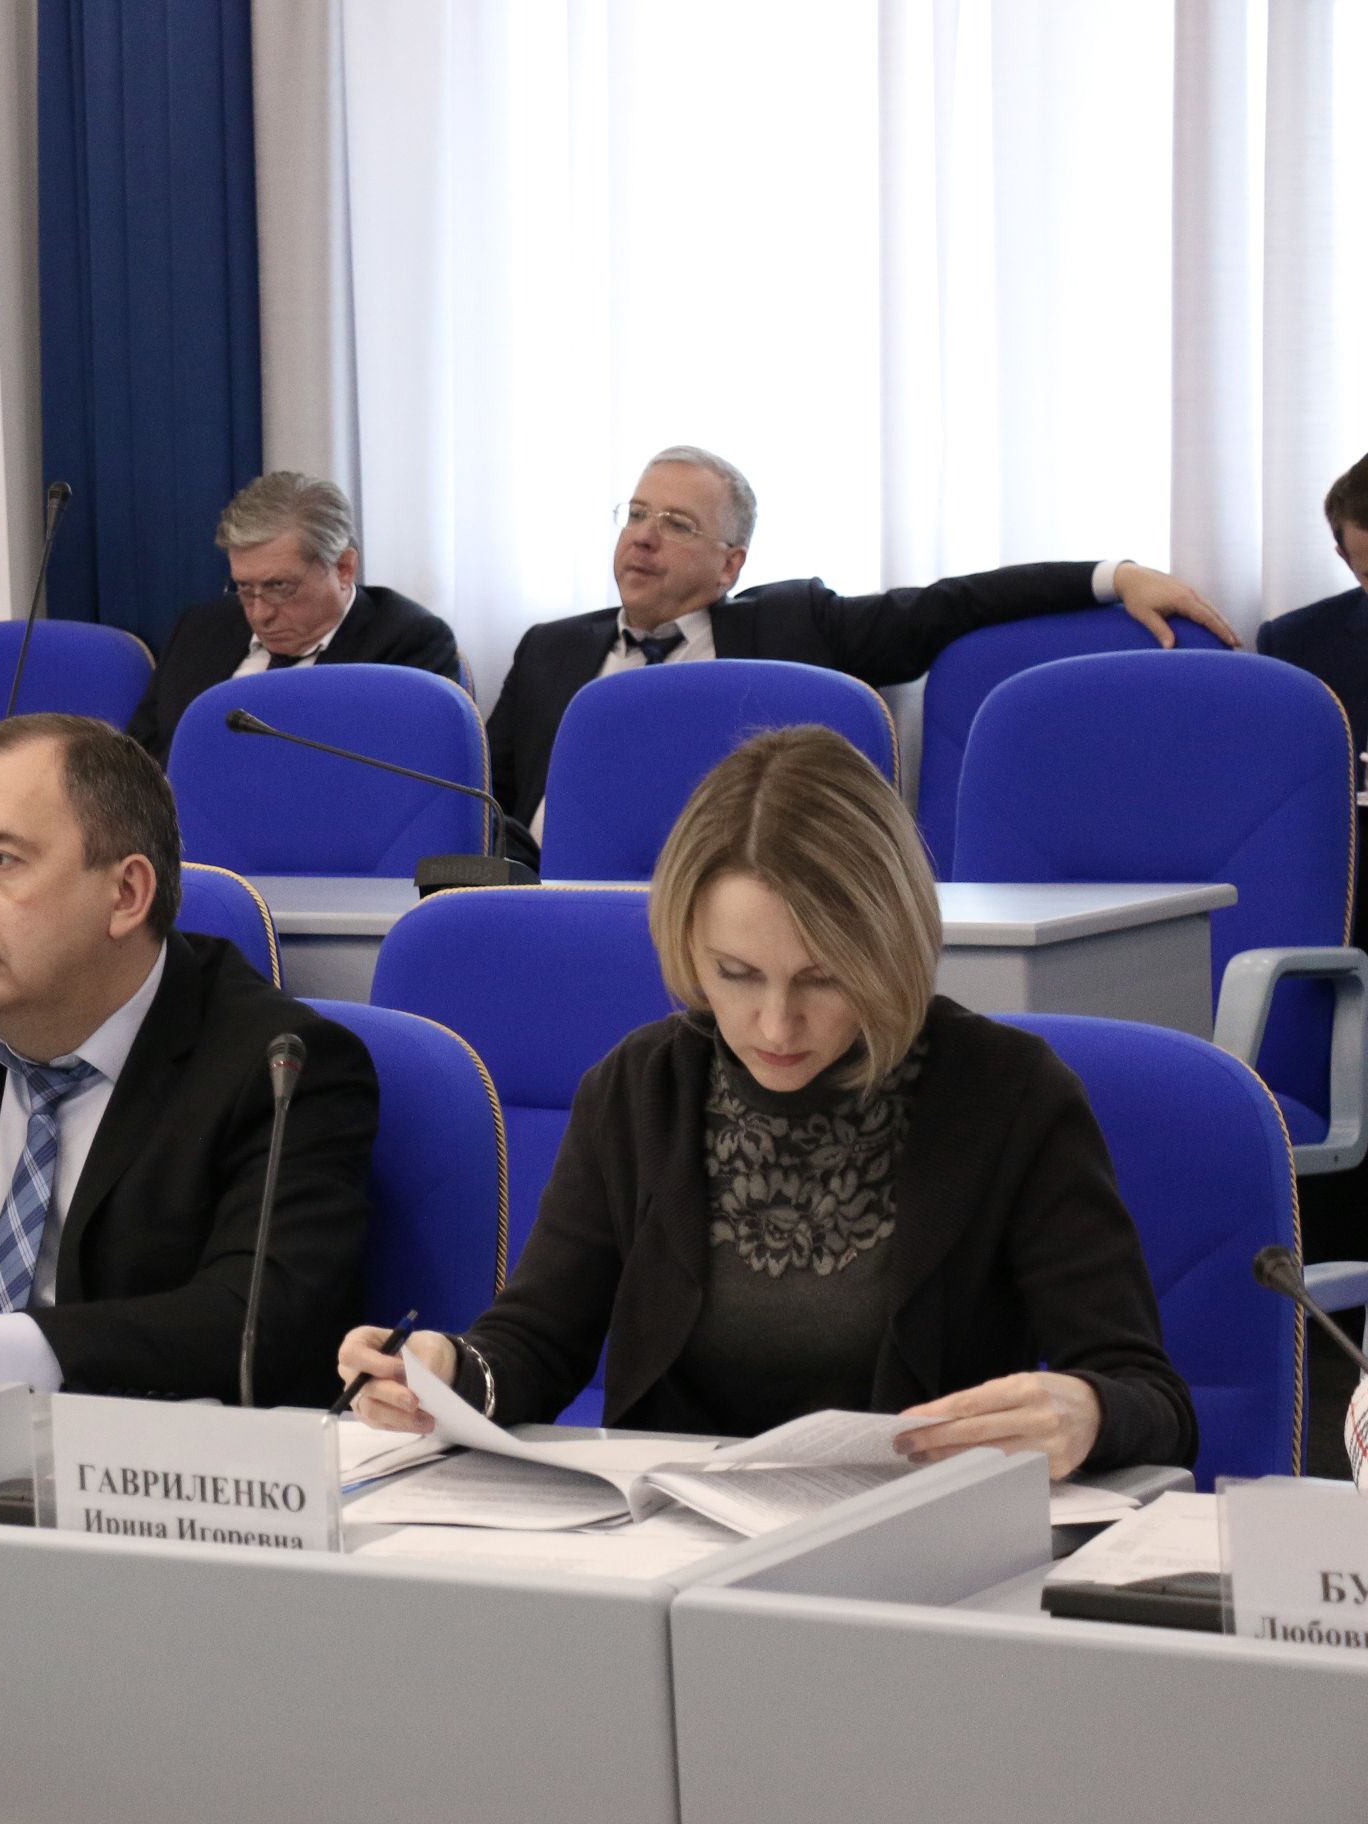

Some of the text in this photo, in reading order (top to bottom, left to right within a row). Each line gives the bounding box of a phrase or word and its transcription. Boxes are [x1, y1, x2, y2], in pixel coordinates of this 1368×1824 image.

[77, 1464, 306, 1512] ГАВРИЛЕНКО
[85, 1508, 304, 1549] Ирина Игоревна
[1254, 1615, 1368, 1648] Любов
